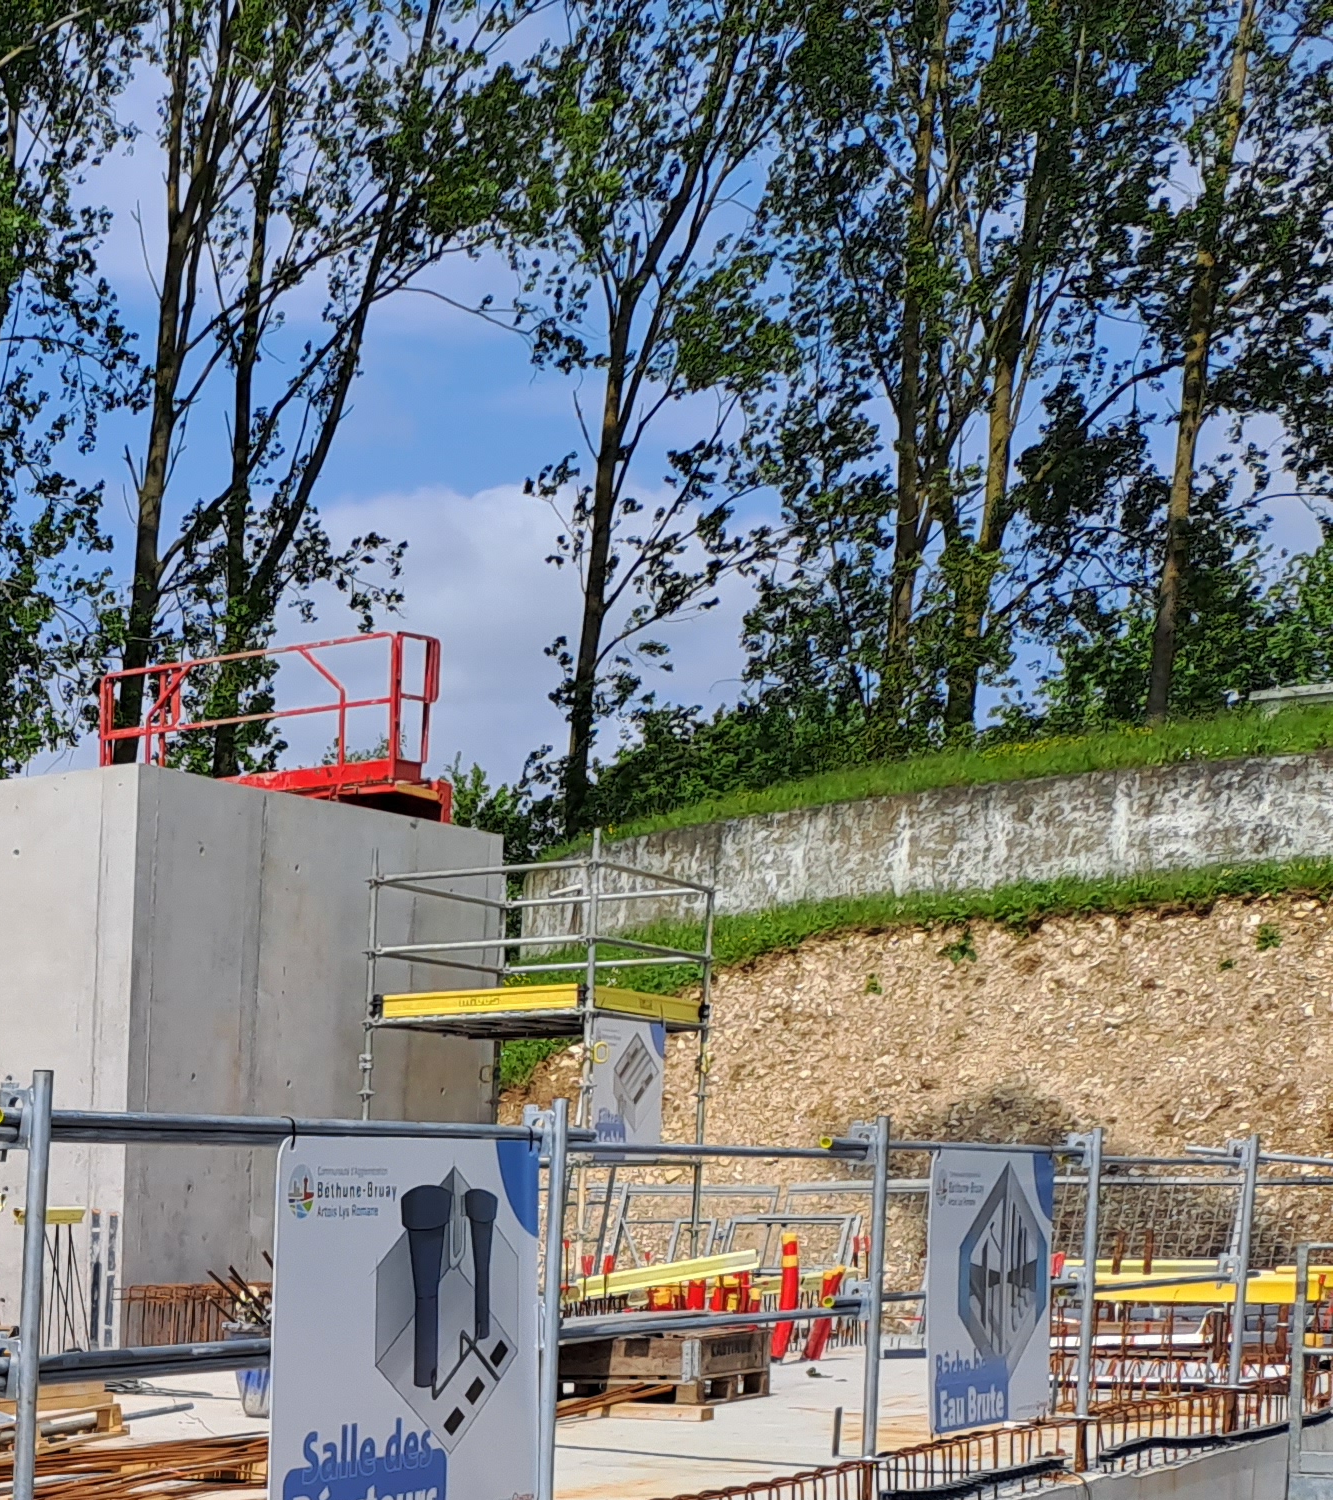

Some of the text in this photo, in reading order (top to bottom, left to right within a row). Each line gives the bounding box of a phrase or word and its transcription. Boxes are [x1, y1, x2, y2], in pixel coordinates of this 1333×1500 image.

[317, 1181, 398, 1203] Béthune-Bruay
[939, 1383, 1005, 1428] Eau Brute
[301, 1416, 433, 1486] Salle des
